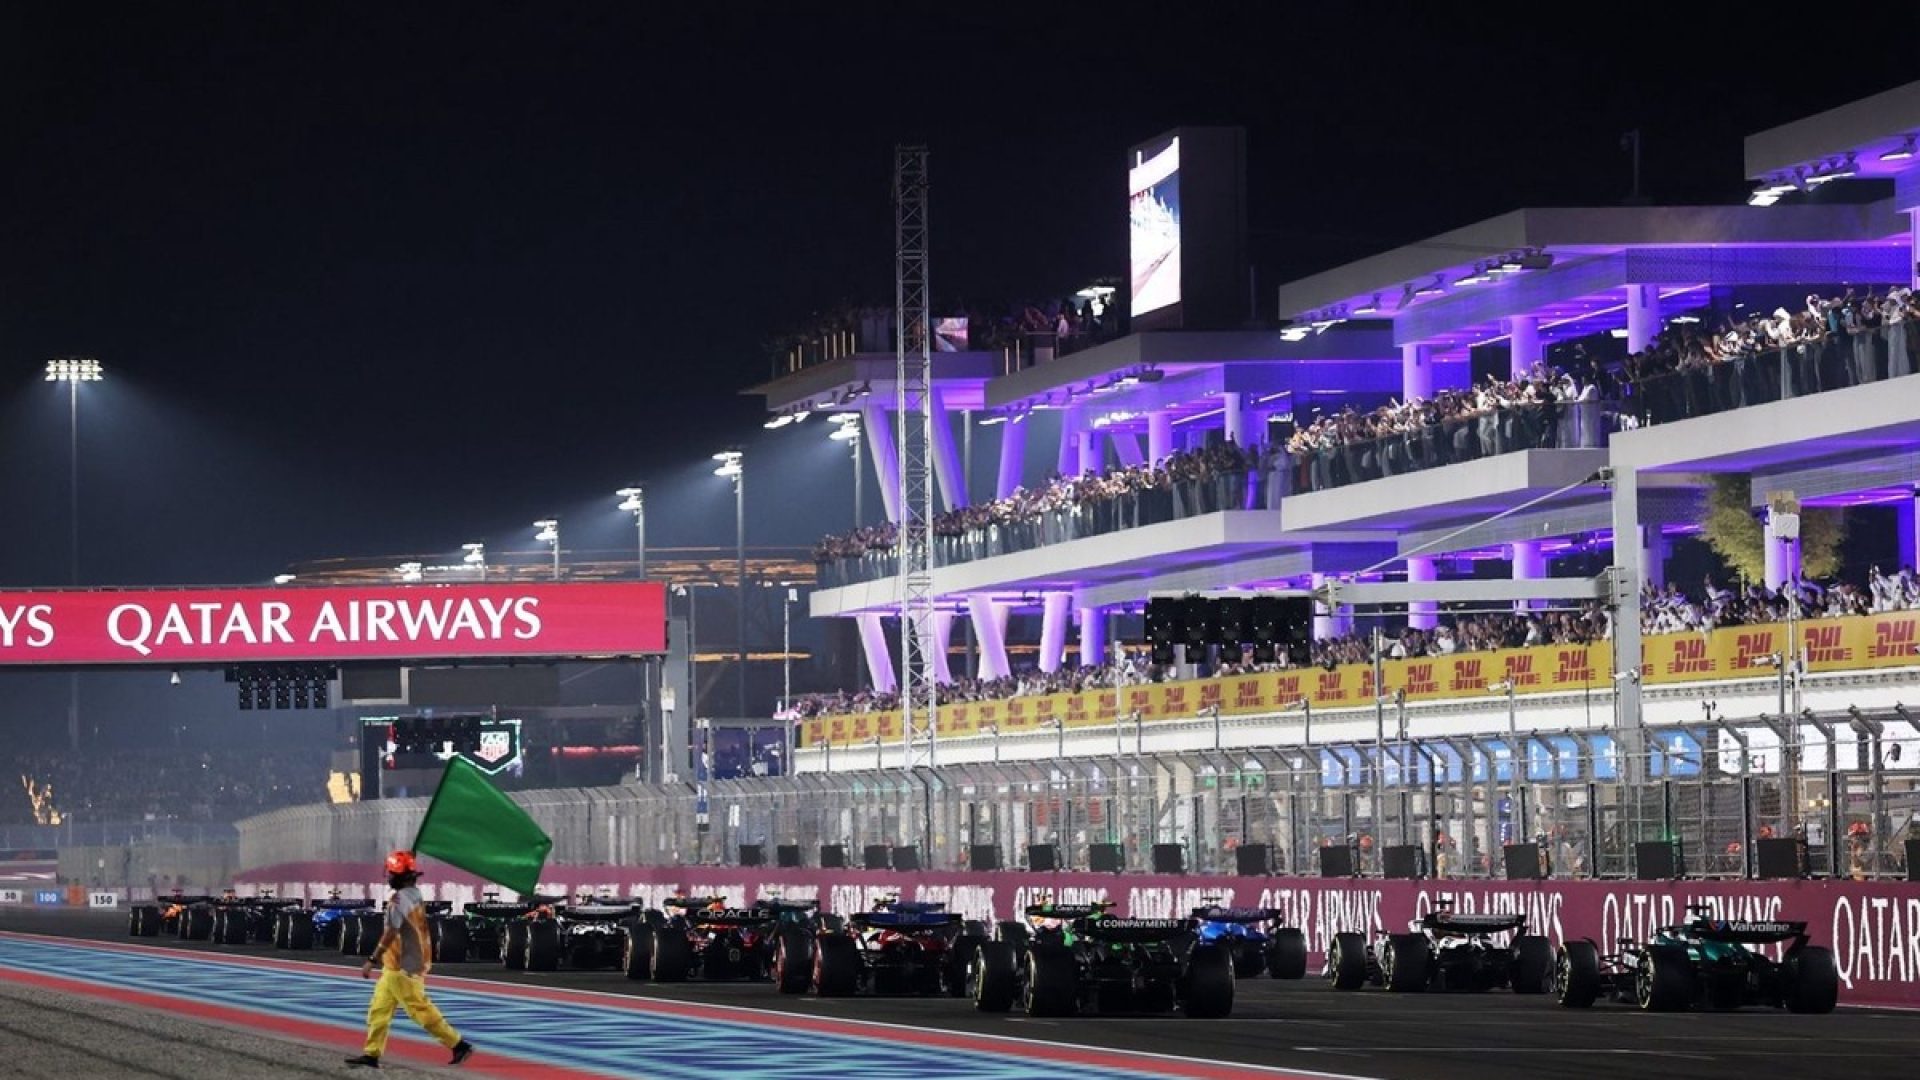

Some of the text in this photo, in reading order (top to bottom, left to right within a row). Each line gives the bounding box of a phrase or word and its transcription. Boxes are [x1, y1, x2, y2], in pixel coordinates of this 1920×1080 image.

[106, 602, 294, 656] QATAR
[308, 596, 542, 642] AIRWAYS
[1876, 620, 1920, 657] DHL
[1674, 639, 1710, 673] DHL
[1804, 626, 1844, 662] DHL
[1407, 664, 1434, 693] DHL
[1454, 659, 1483, 690] DHL
[1558, 650, 1589, 682] DHL
[40, 893, 57, 902] 100
[95, 895, 113, 905] 150
[697, 908, 769, 919] ORACLE
[1103, 919, 1179, 929] COINPAYMENTS
[1729, 921, 1790, 932] Valvoline
[1833, 896, 1920, 989] QATAR
